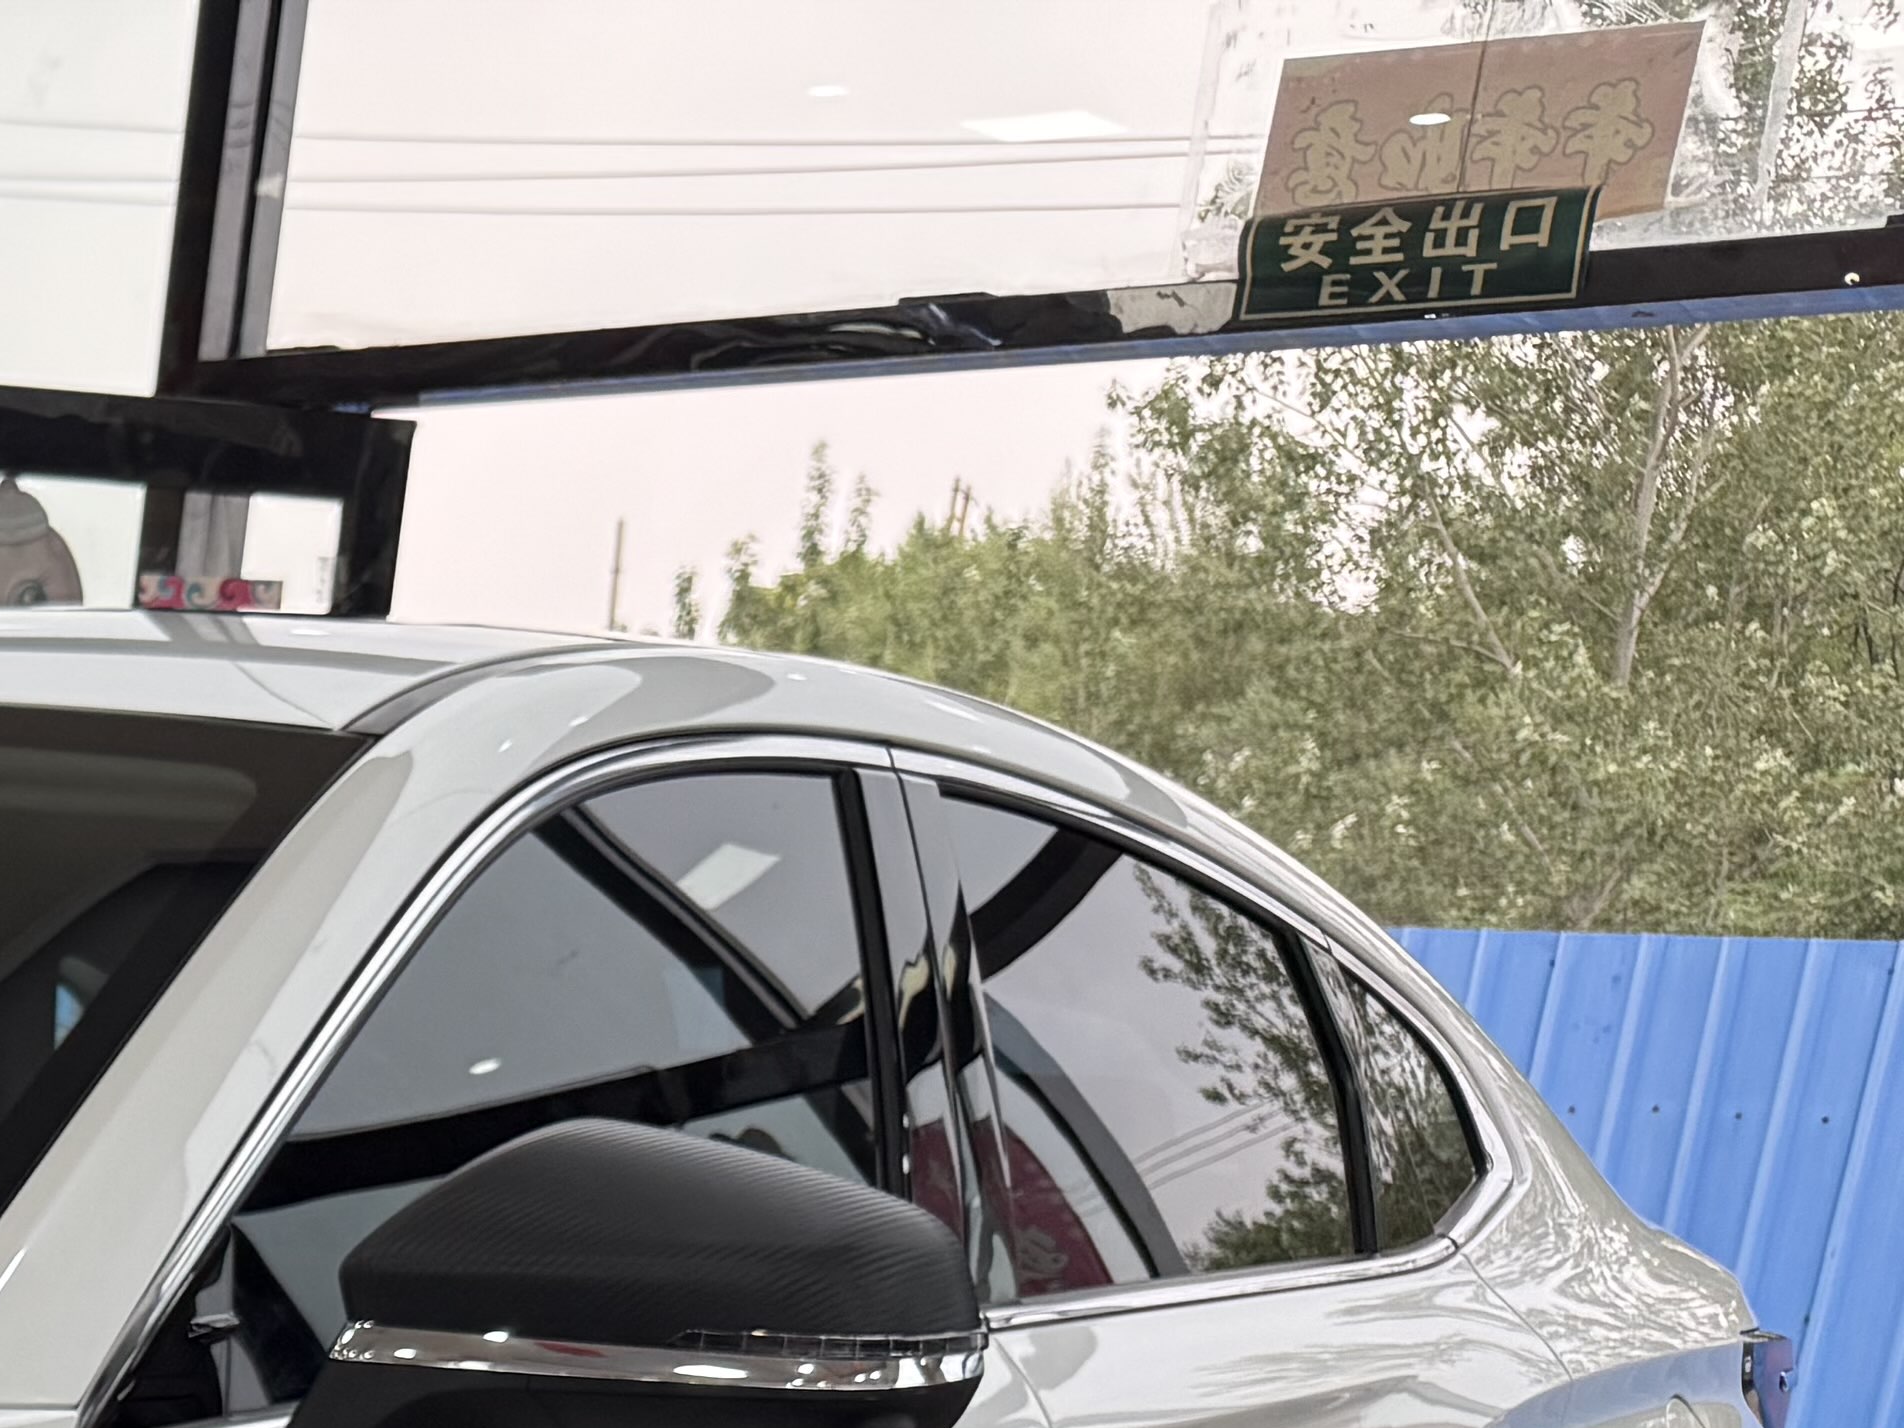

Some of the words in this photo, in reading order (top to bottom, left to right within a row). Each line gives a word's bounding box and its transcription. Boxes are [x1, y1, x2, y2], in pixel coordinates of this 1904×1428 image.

[1278, 196, 1559, 274] 安全出口
[1318, 262, 1500, 308] EXIT
